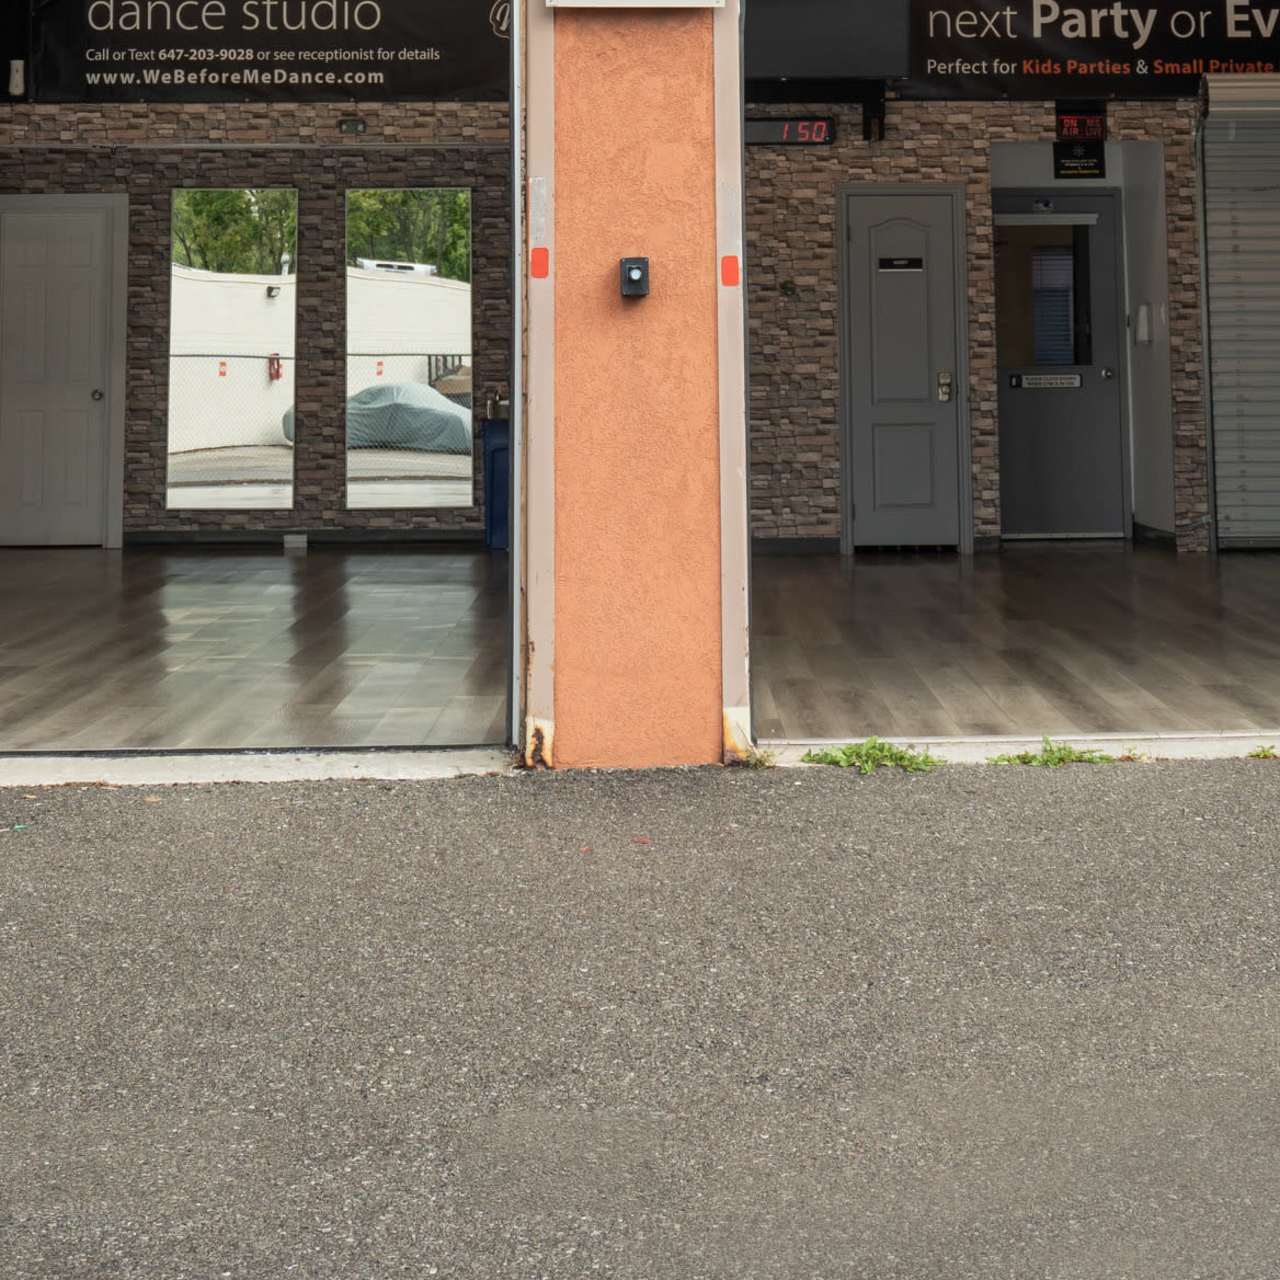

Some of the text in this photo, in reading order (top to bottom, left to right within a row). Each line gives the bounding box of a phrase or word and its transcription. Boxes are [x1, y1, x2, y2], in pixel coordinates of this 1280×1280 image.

[927, 6, 1019, 39] next
[1170, 9, 1213, 39] or
[85, 48, 441, 64] Call or Text 647-203-9028 or see receptionist for details
[926, 58, 988, 75] Perfect
[993, 58, 1018, 74] for
[1022, 58, 1062, 75] Kids
[1066, 58, 1132, 75] Parties
[1135, 60, 1149, 75] &
[1152, 59, 1204, 74] Small
[1208, 60, 1275, 73] Private
[85, 68, 385, 85] www.WeBeforeMeDance.com
